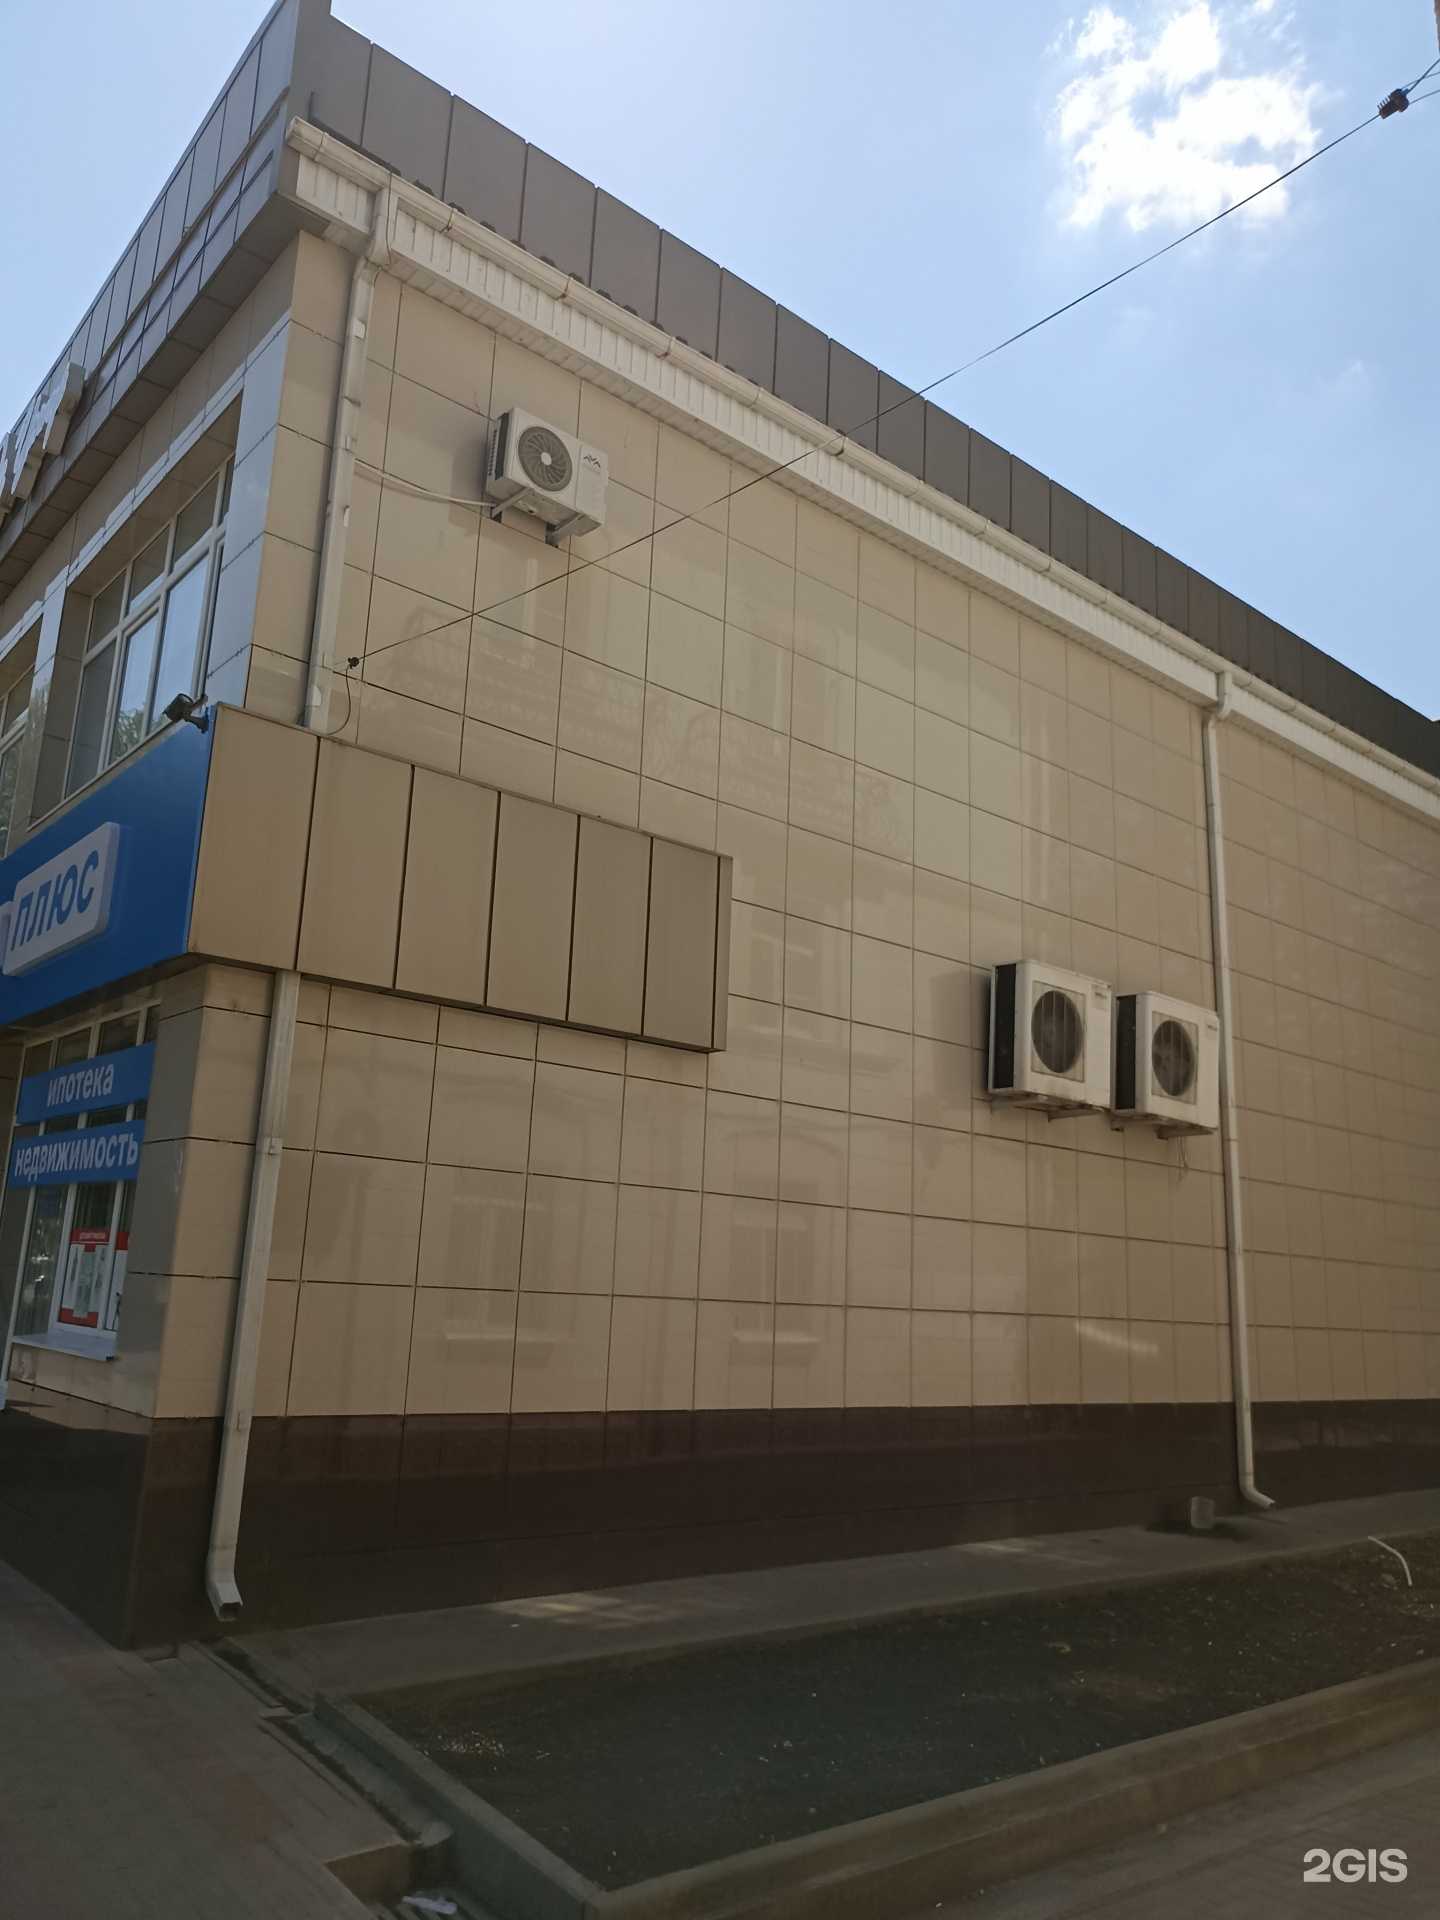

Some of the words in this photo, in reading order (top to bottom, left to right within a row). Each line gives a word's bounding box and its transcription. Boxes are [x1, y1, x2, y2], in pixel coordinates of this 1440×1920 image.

[10, 850, 99, 951] ПЛЮС
[47, 1064, 114, 1107] ипотека
[14, 1133, 138, 1182] недвижимость
